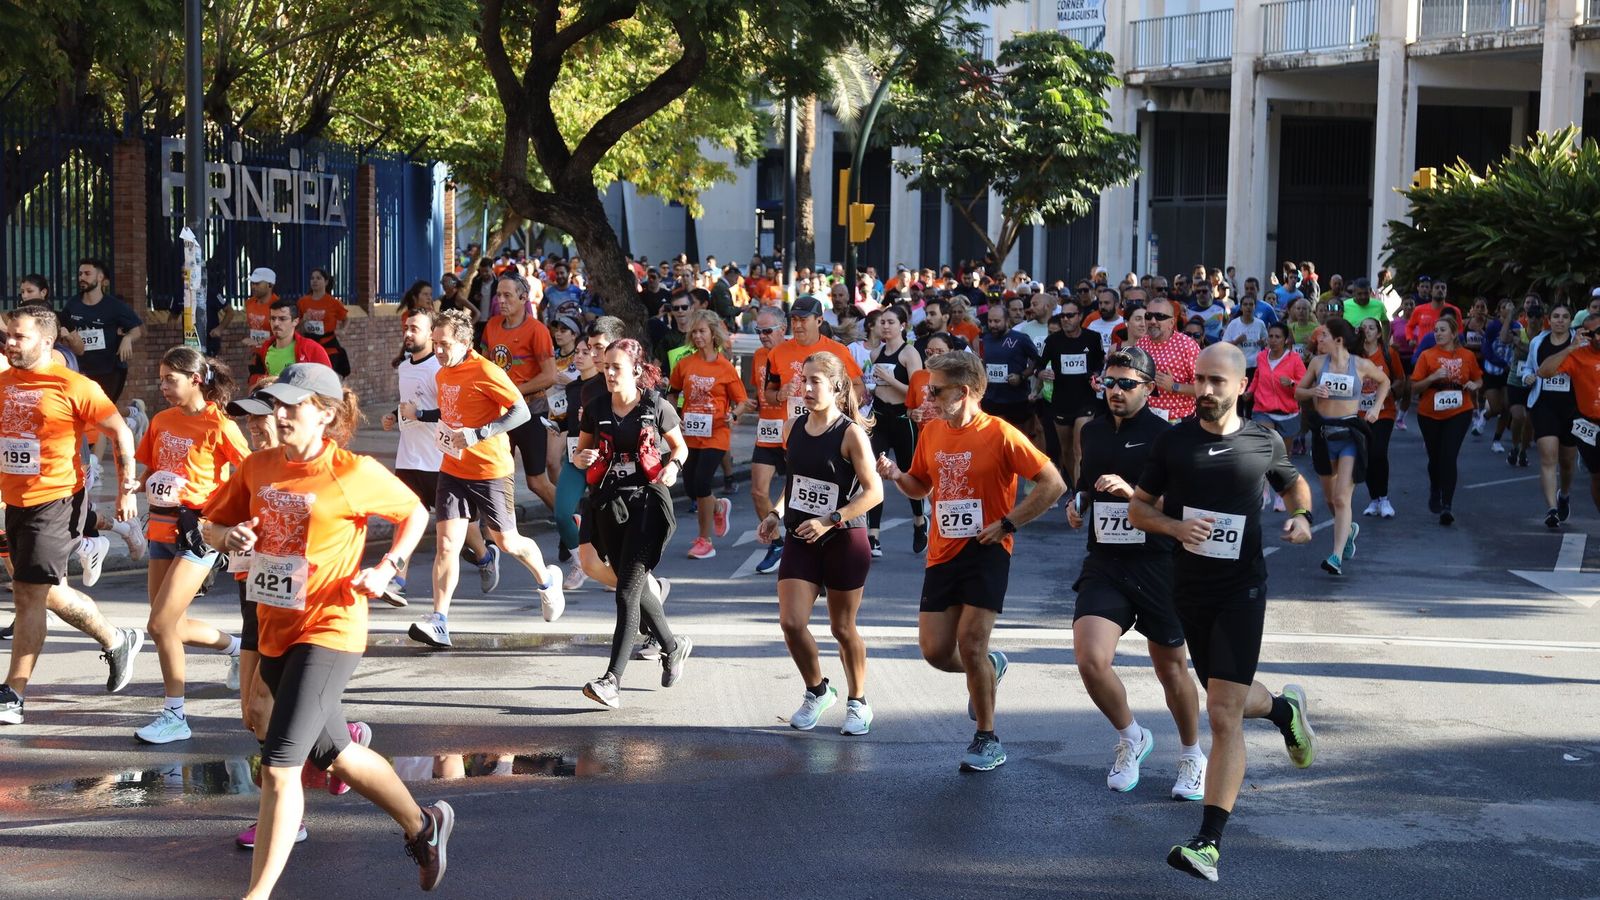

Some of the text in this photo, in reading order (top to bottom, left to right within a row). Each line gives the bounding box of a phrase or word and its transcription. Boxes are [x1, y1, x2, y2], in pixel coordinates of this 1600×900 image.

[1057, 0, 1085, 10] CORNER
[1057, 9, 1099, 21] MALAGUISTA
[1063, 360, 1085, 368] 1072
[988, 370, 1004, 378] 488
[1438, 397, 1458, 405] 444
[686, 420, 706, 430] 597
[760, 427, 779, 436] 854
[1574, 422, 1594, 438] 795
[439, 431, 455, 446] 72
[3, 450, 31, 464] 199
[150, 482, 172, 497] 184
[798, 488, 829, 506] 595
[941, 512, 973, 527] 276
[1100, 517, 1135, 531] 770
[1206, 528, 1238, 543] 20
[254, 572, 292, 594] 421
